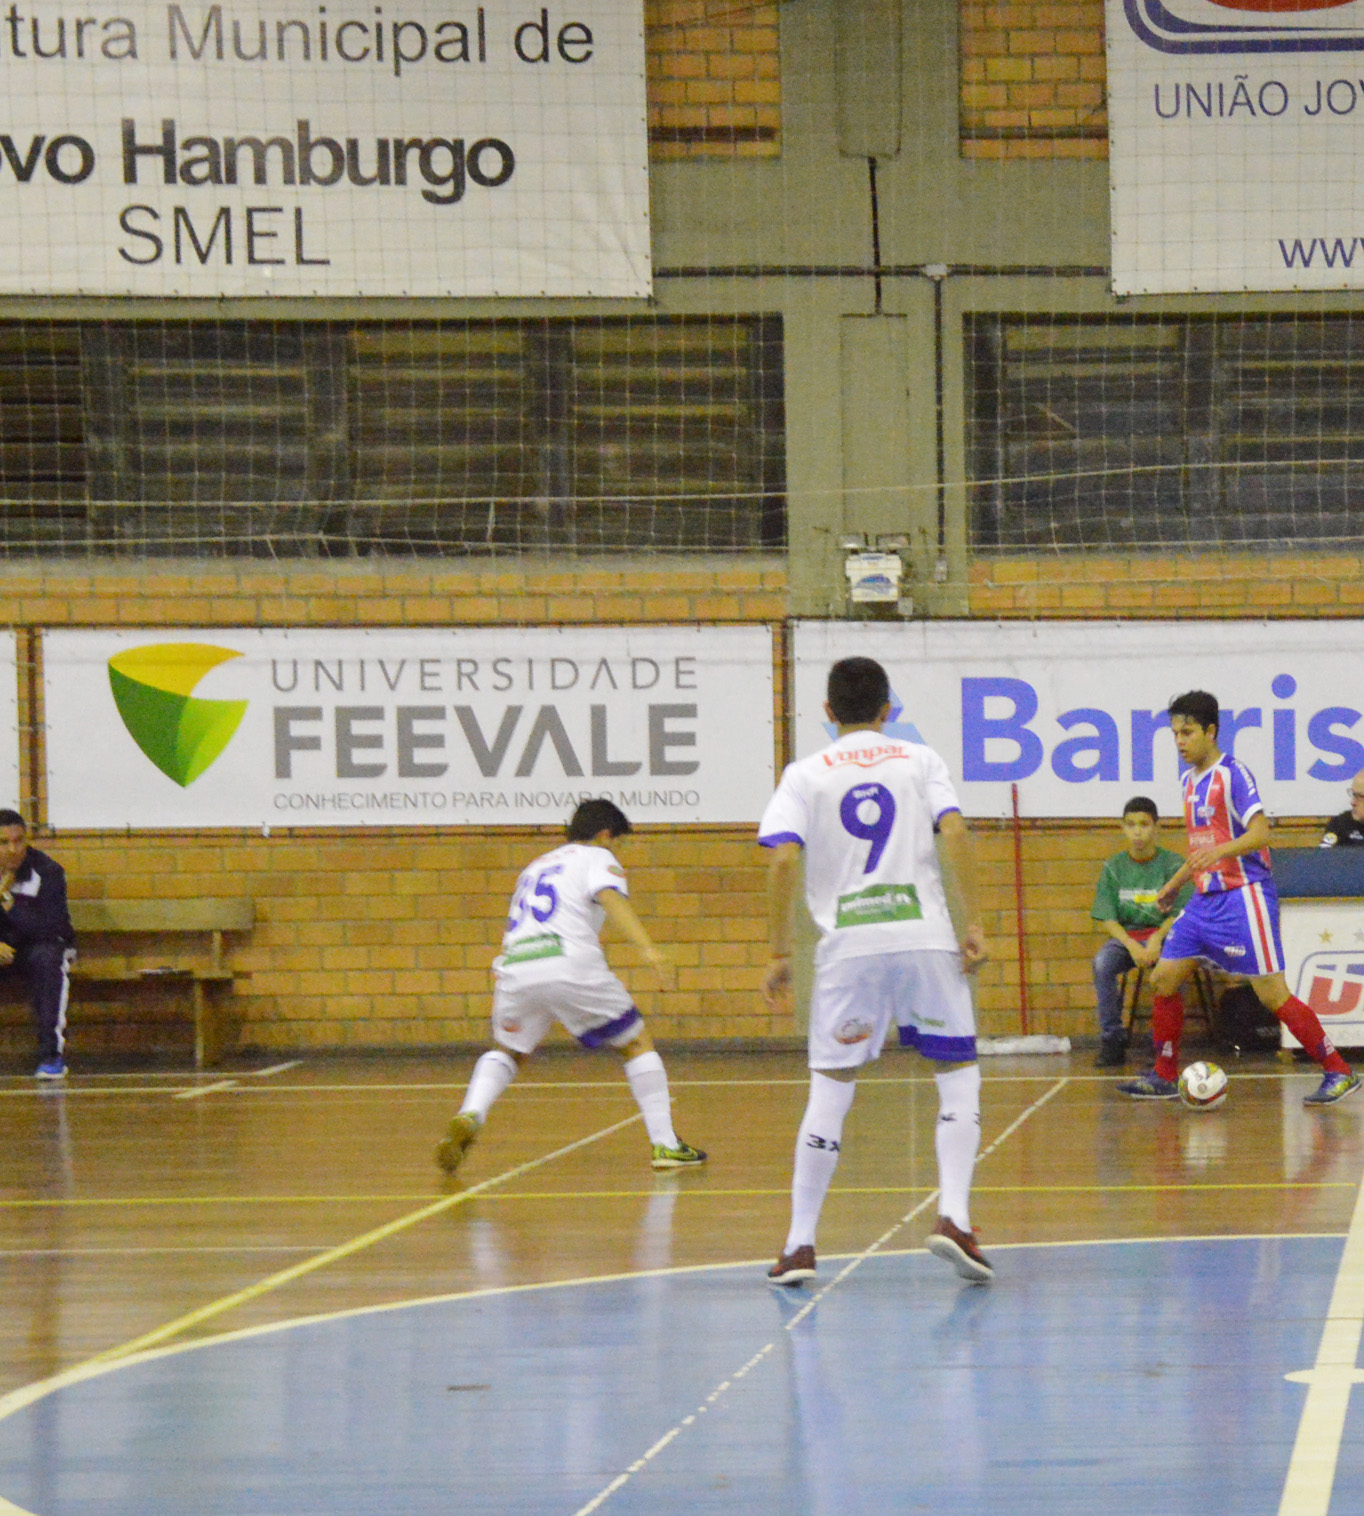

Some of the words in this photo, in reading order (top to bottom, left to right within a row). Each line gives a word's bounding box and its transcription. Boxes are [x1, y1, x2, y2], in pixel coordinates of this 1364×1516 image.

[4, 3, 139, 60] tura
[167, 4, 487, 77] Municipal
[514, 8, 594, 63] de
[1154, 74, 1289, 119] UNIÃO
[0, 134, 95, 184] vo
[121, 117, 516, 205] Hamburgo
[118, 204, 331, 266] SMEL
[271, 656, 698, 692] UNIVERSIDADE
[273, 703, 701, 779] FEEVALE
[273, 791, 448, 810] CONHECIMENTO
[452, 791, 510, 809] PARA
[619, 789, 701, 807] MUNDO
[839, 781, 897, 875] 9
